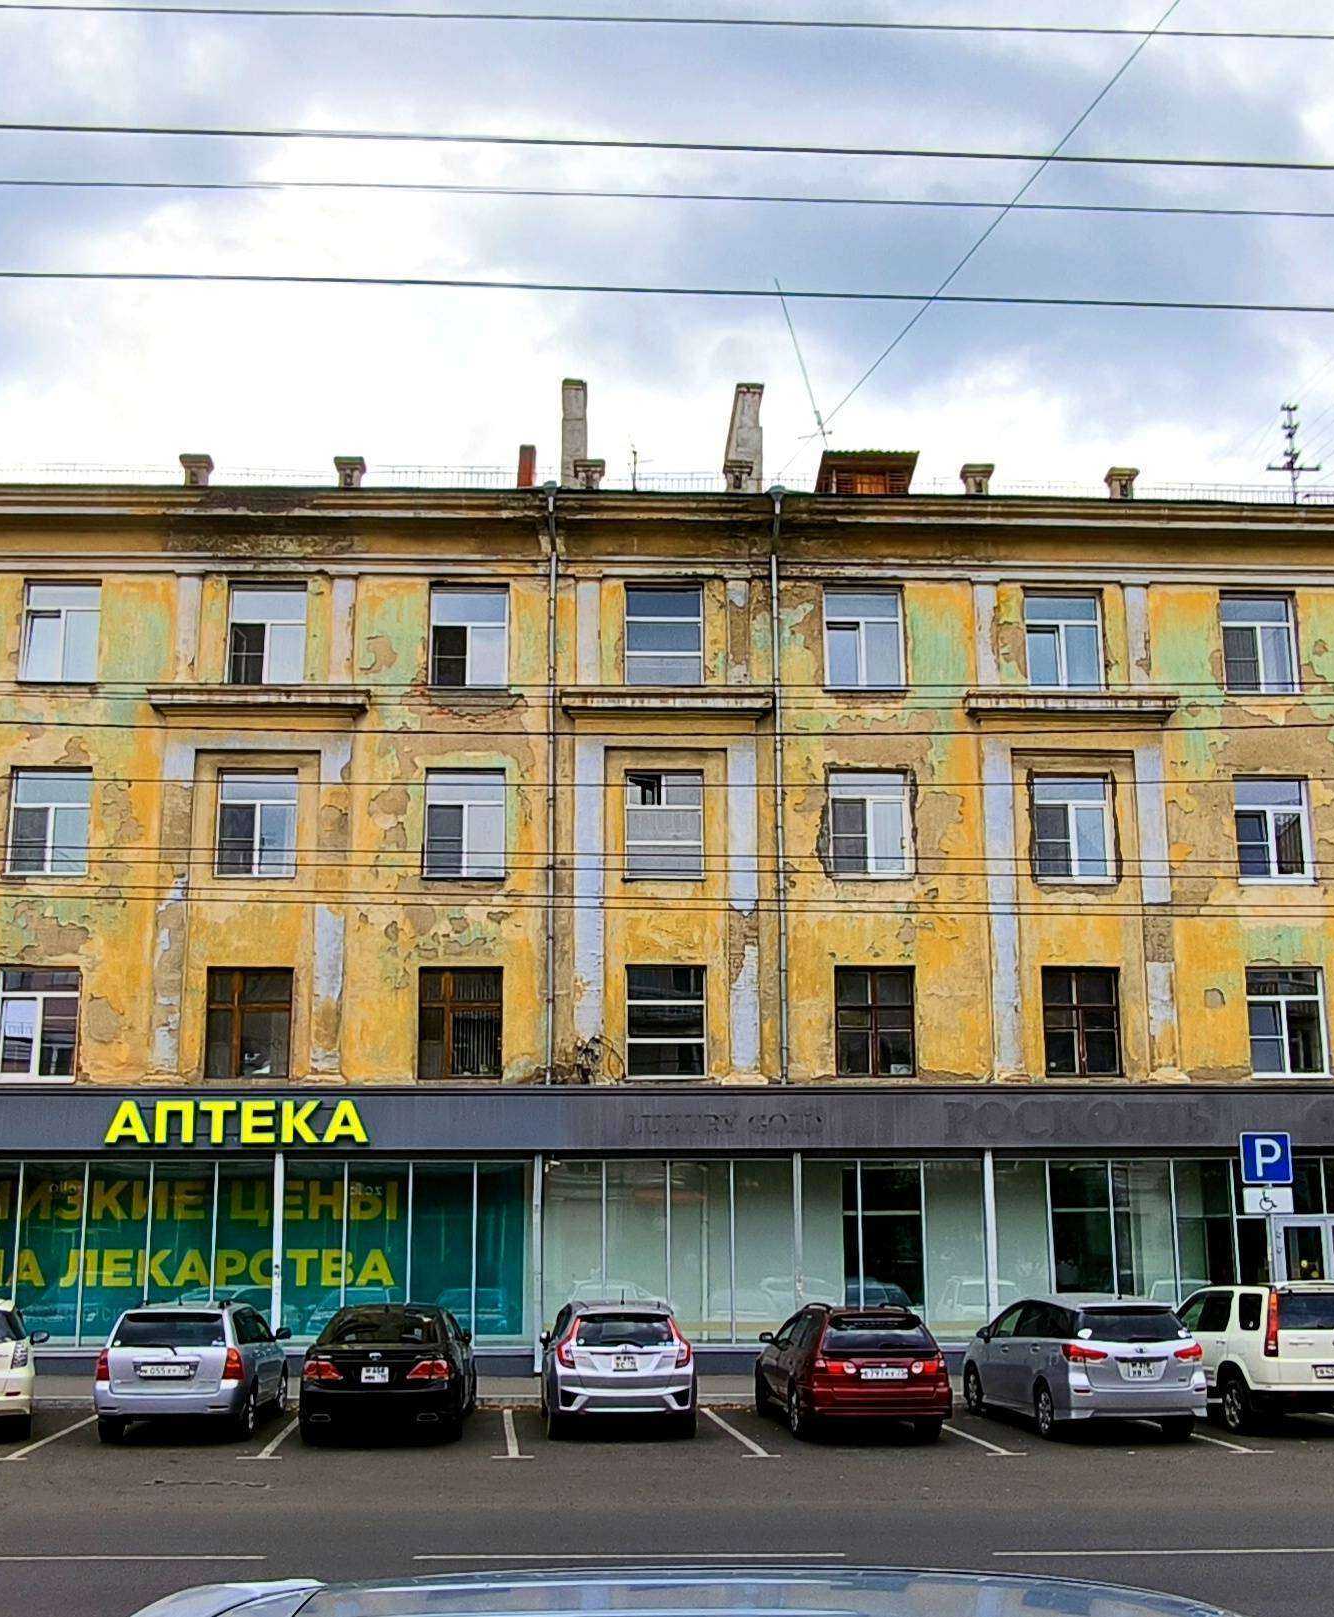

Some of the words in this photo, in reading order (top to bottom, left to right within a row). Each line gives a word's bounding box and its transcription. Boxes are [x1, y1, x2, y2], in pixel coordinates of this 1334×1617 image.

[104, 1099, 369, 1144] АПТЕКА
[1254, 1138, 1282, 1177] P
[229, 1179, 399, 1227] ЦЕНЫ
[59, 1247, 395, 1288] ЛЕКАРСТВА
